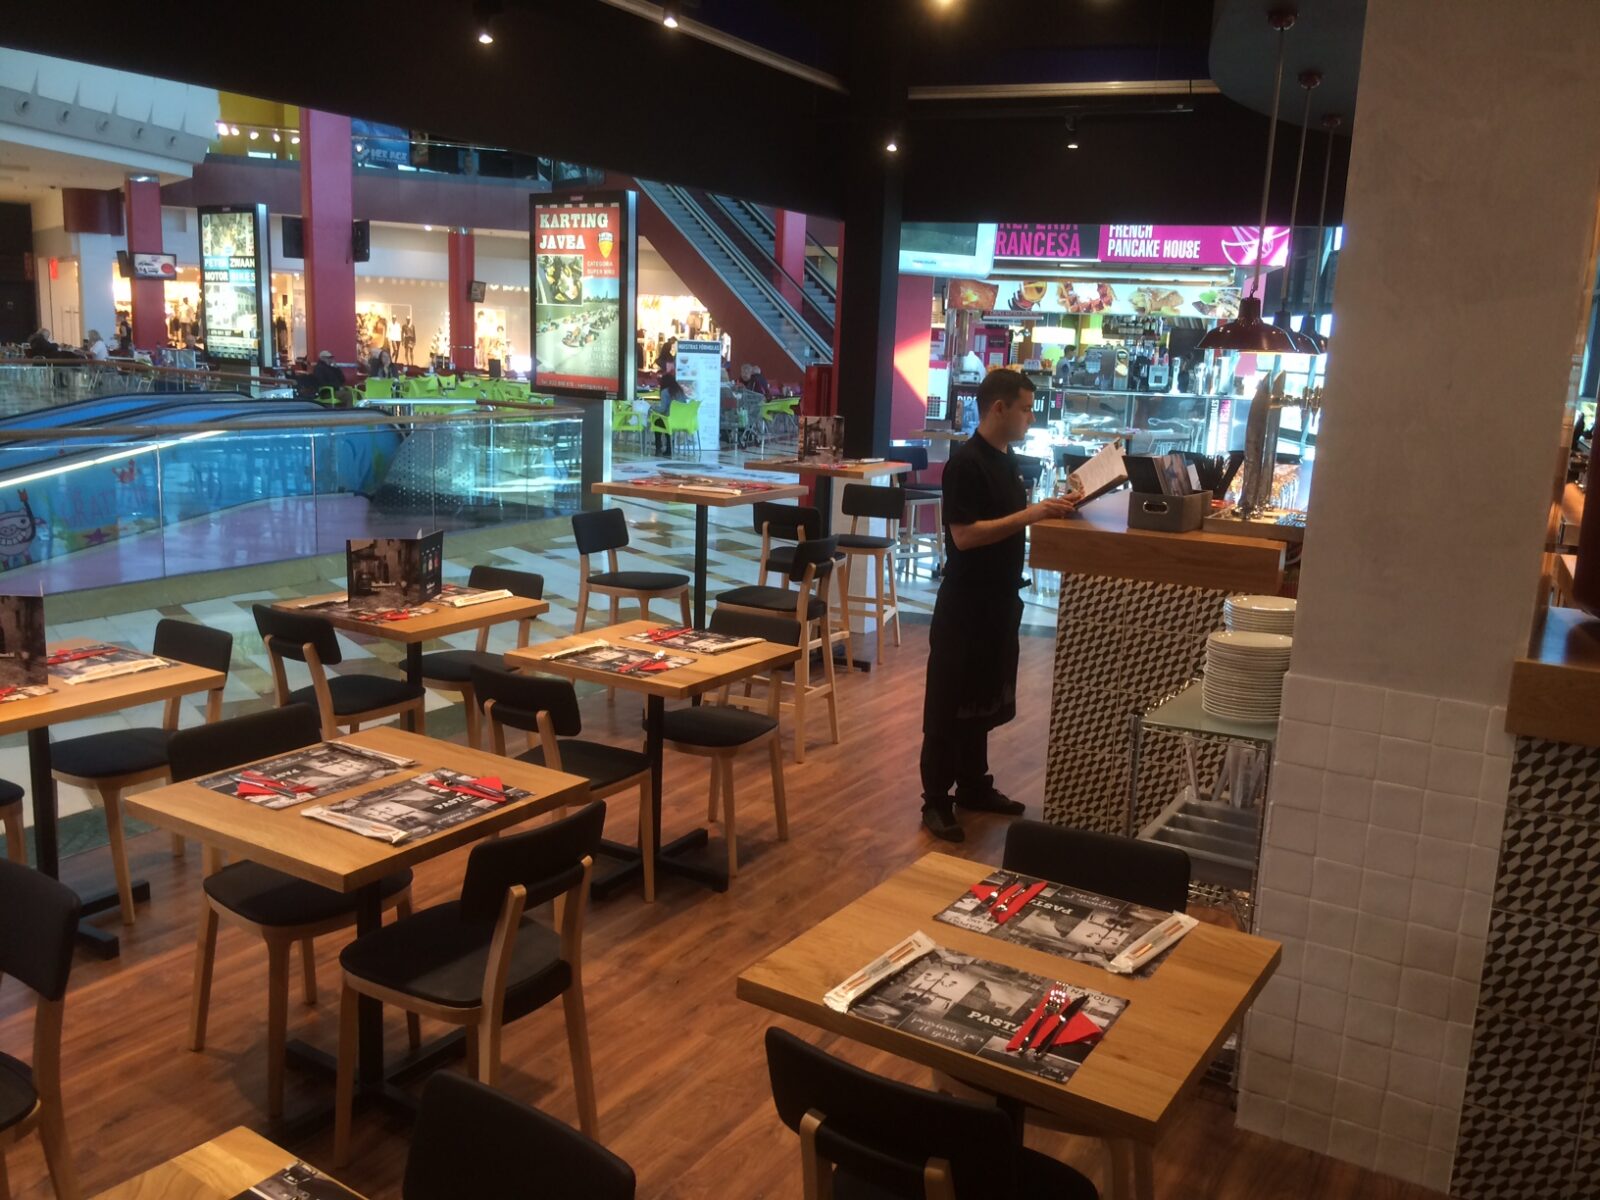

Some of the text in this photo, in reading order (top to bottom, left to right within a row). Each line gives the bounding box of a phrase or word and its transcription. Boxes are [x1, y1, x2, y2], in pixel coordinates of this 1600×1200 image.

[540, 213, 608, 228] KARTING
[1109, 225, 1153, 238] FRENCH
[539, 234, 586, 249] JAVEA
[1107, 239, 1201, 259] PANCAKE HOUSE
[230, 258, 255, 268] ZWAAN
[204, 271, 228, 281] MOTOR
